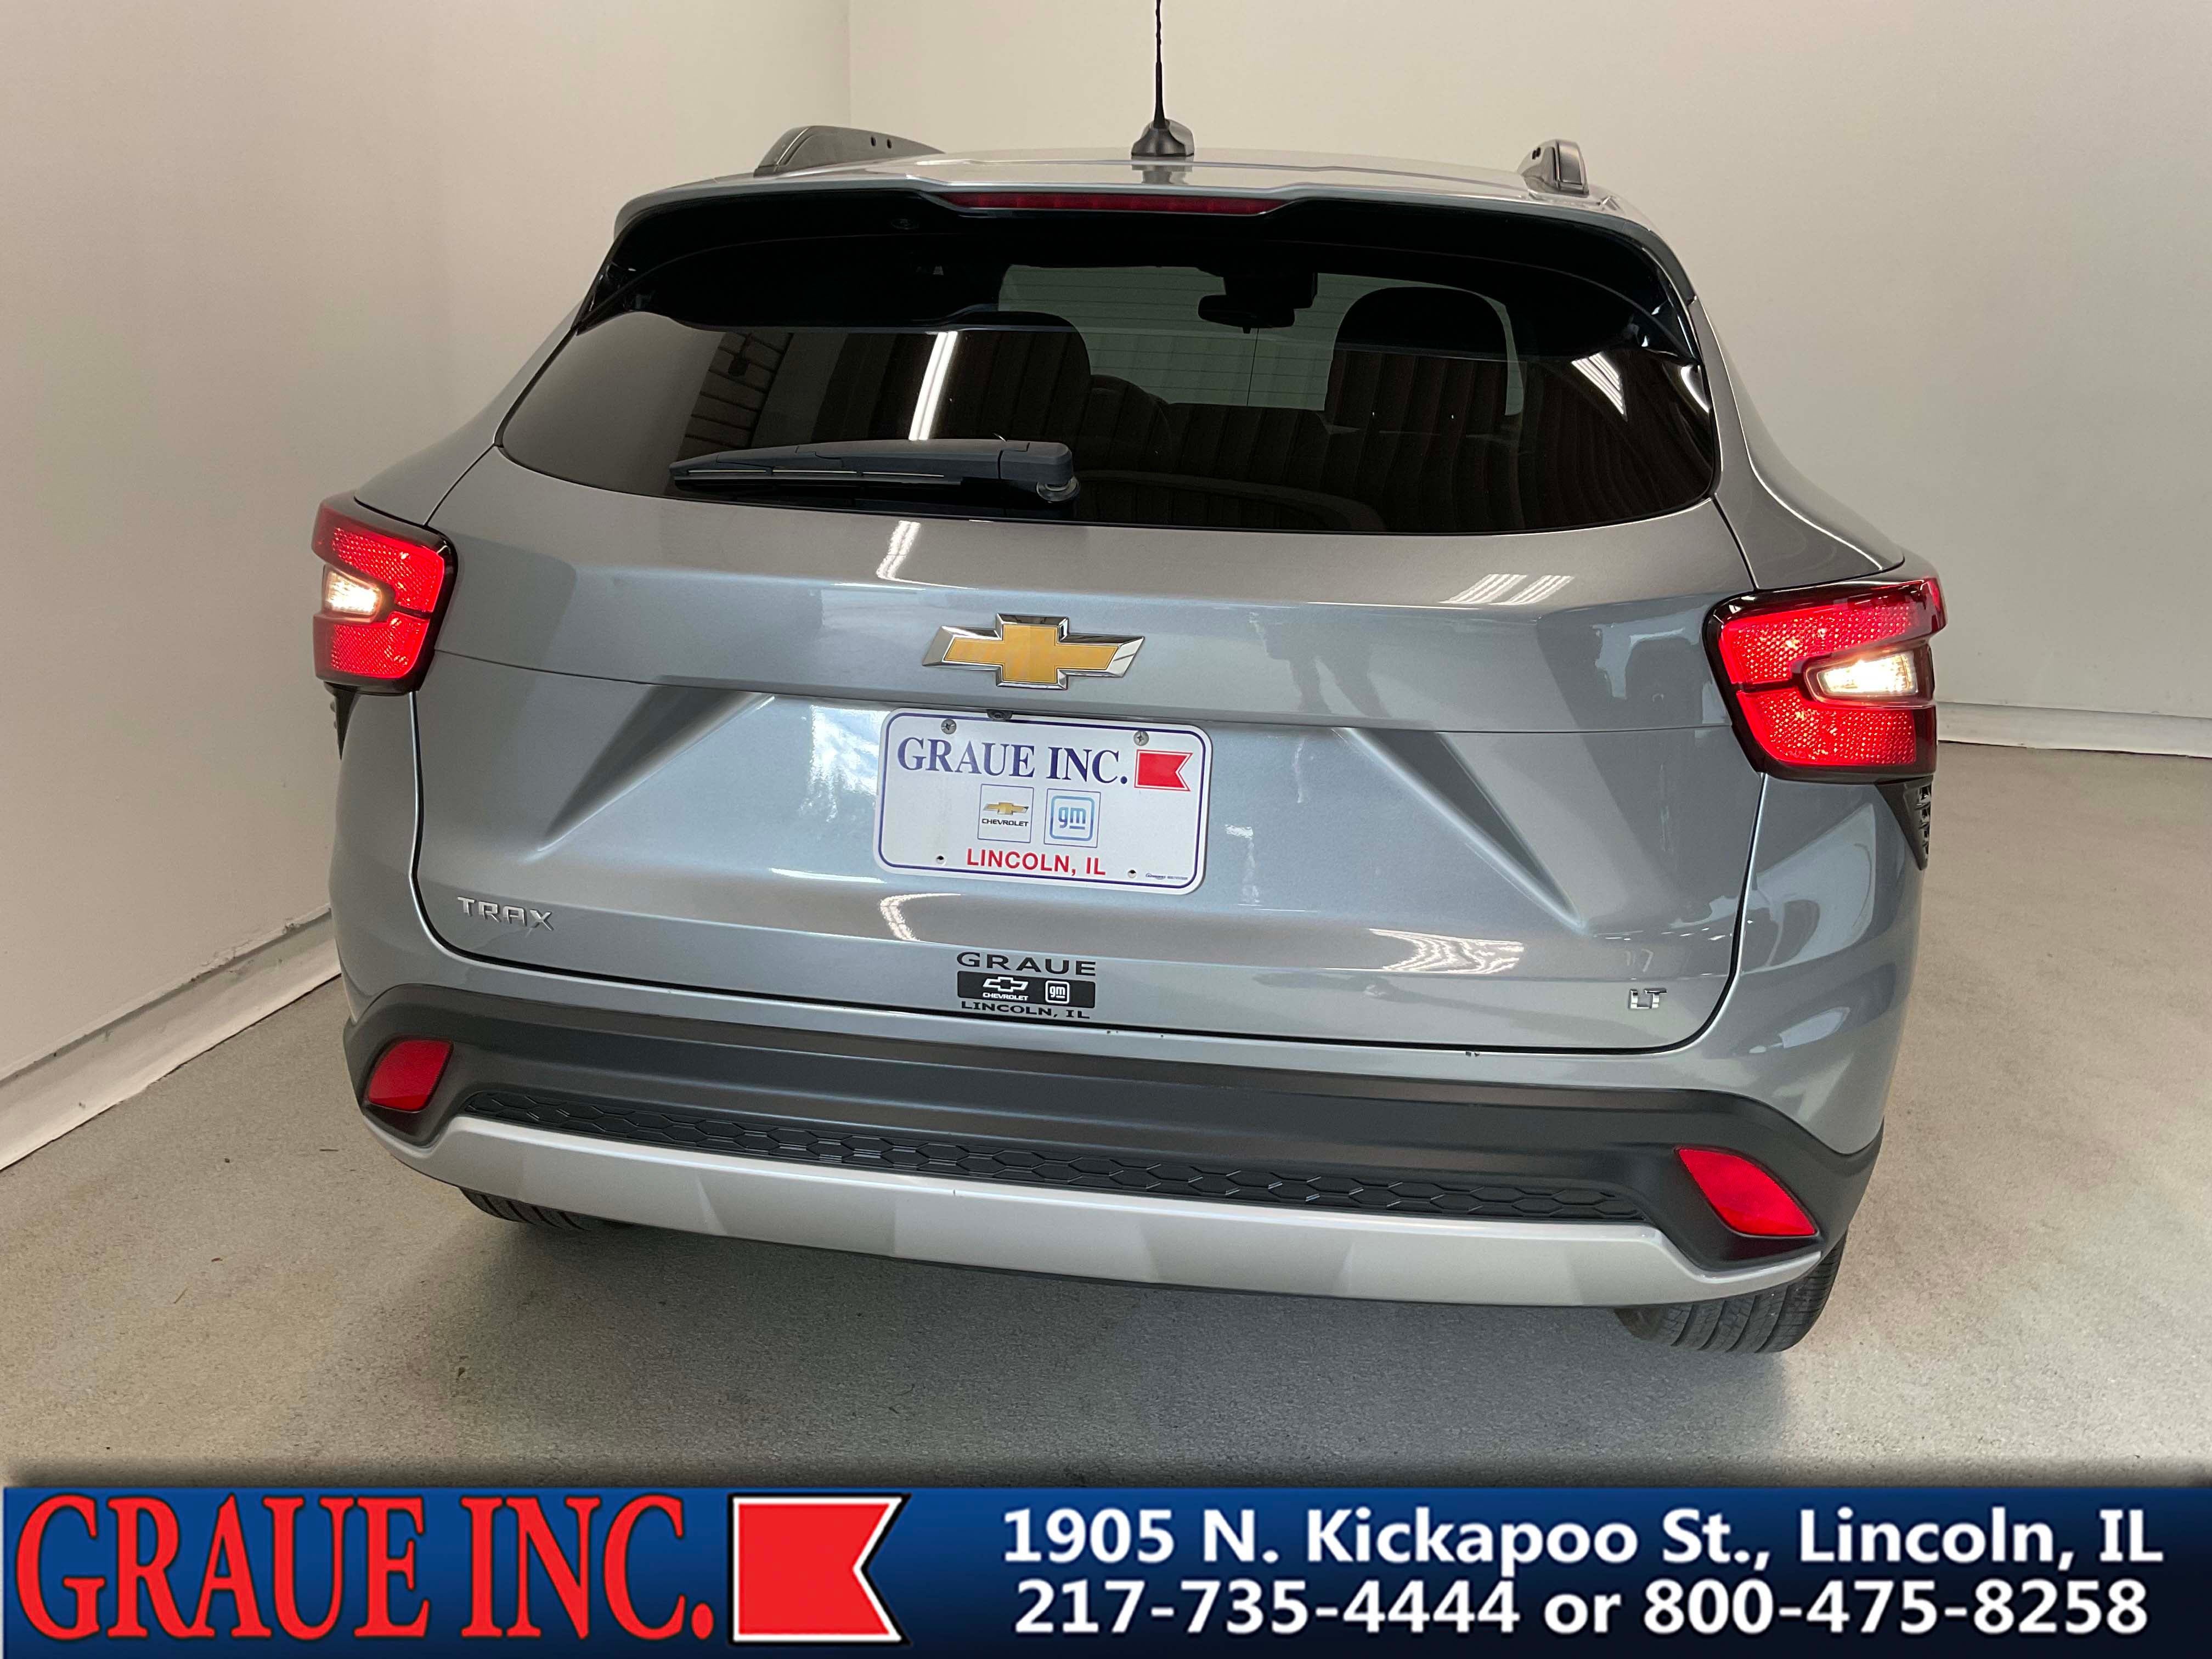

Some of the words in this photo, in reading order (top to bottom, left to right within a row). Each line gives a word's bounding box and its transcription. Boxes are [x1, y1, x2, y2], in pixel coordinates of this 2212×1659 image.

[897, 737, 1035, 777] GRAUE
[1047, 747, 1128, 784] INC.
[982, 818, 1029, 827] CHEVROLET
[1058, 806, 1087, 830] gm
[967, 848, 1076, 876] LINCOLN,
[1086, 857, 1106, 875] IL
[457, 896, 554, 931] TRAX
[957, 952, 1096, 976] GRAUE
[983, 992, 1029, 1001] CHEVROLET
[1049, 985, 1065, 998] gm
[1628, 988, 1667, 1009] LT
[961, 1001, 1058, 1018] LINCOLN,
[1066, 1009, 1090, 1019] IL
